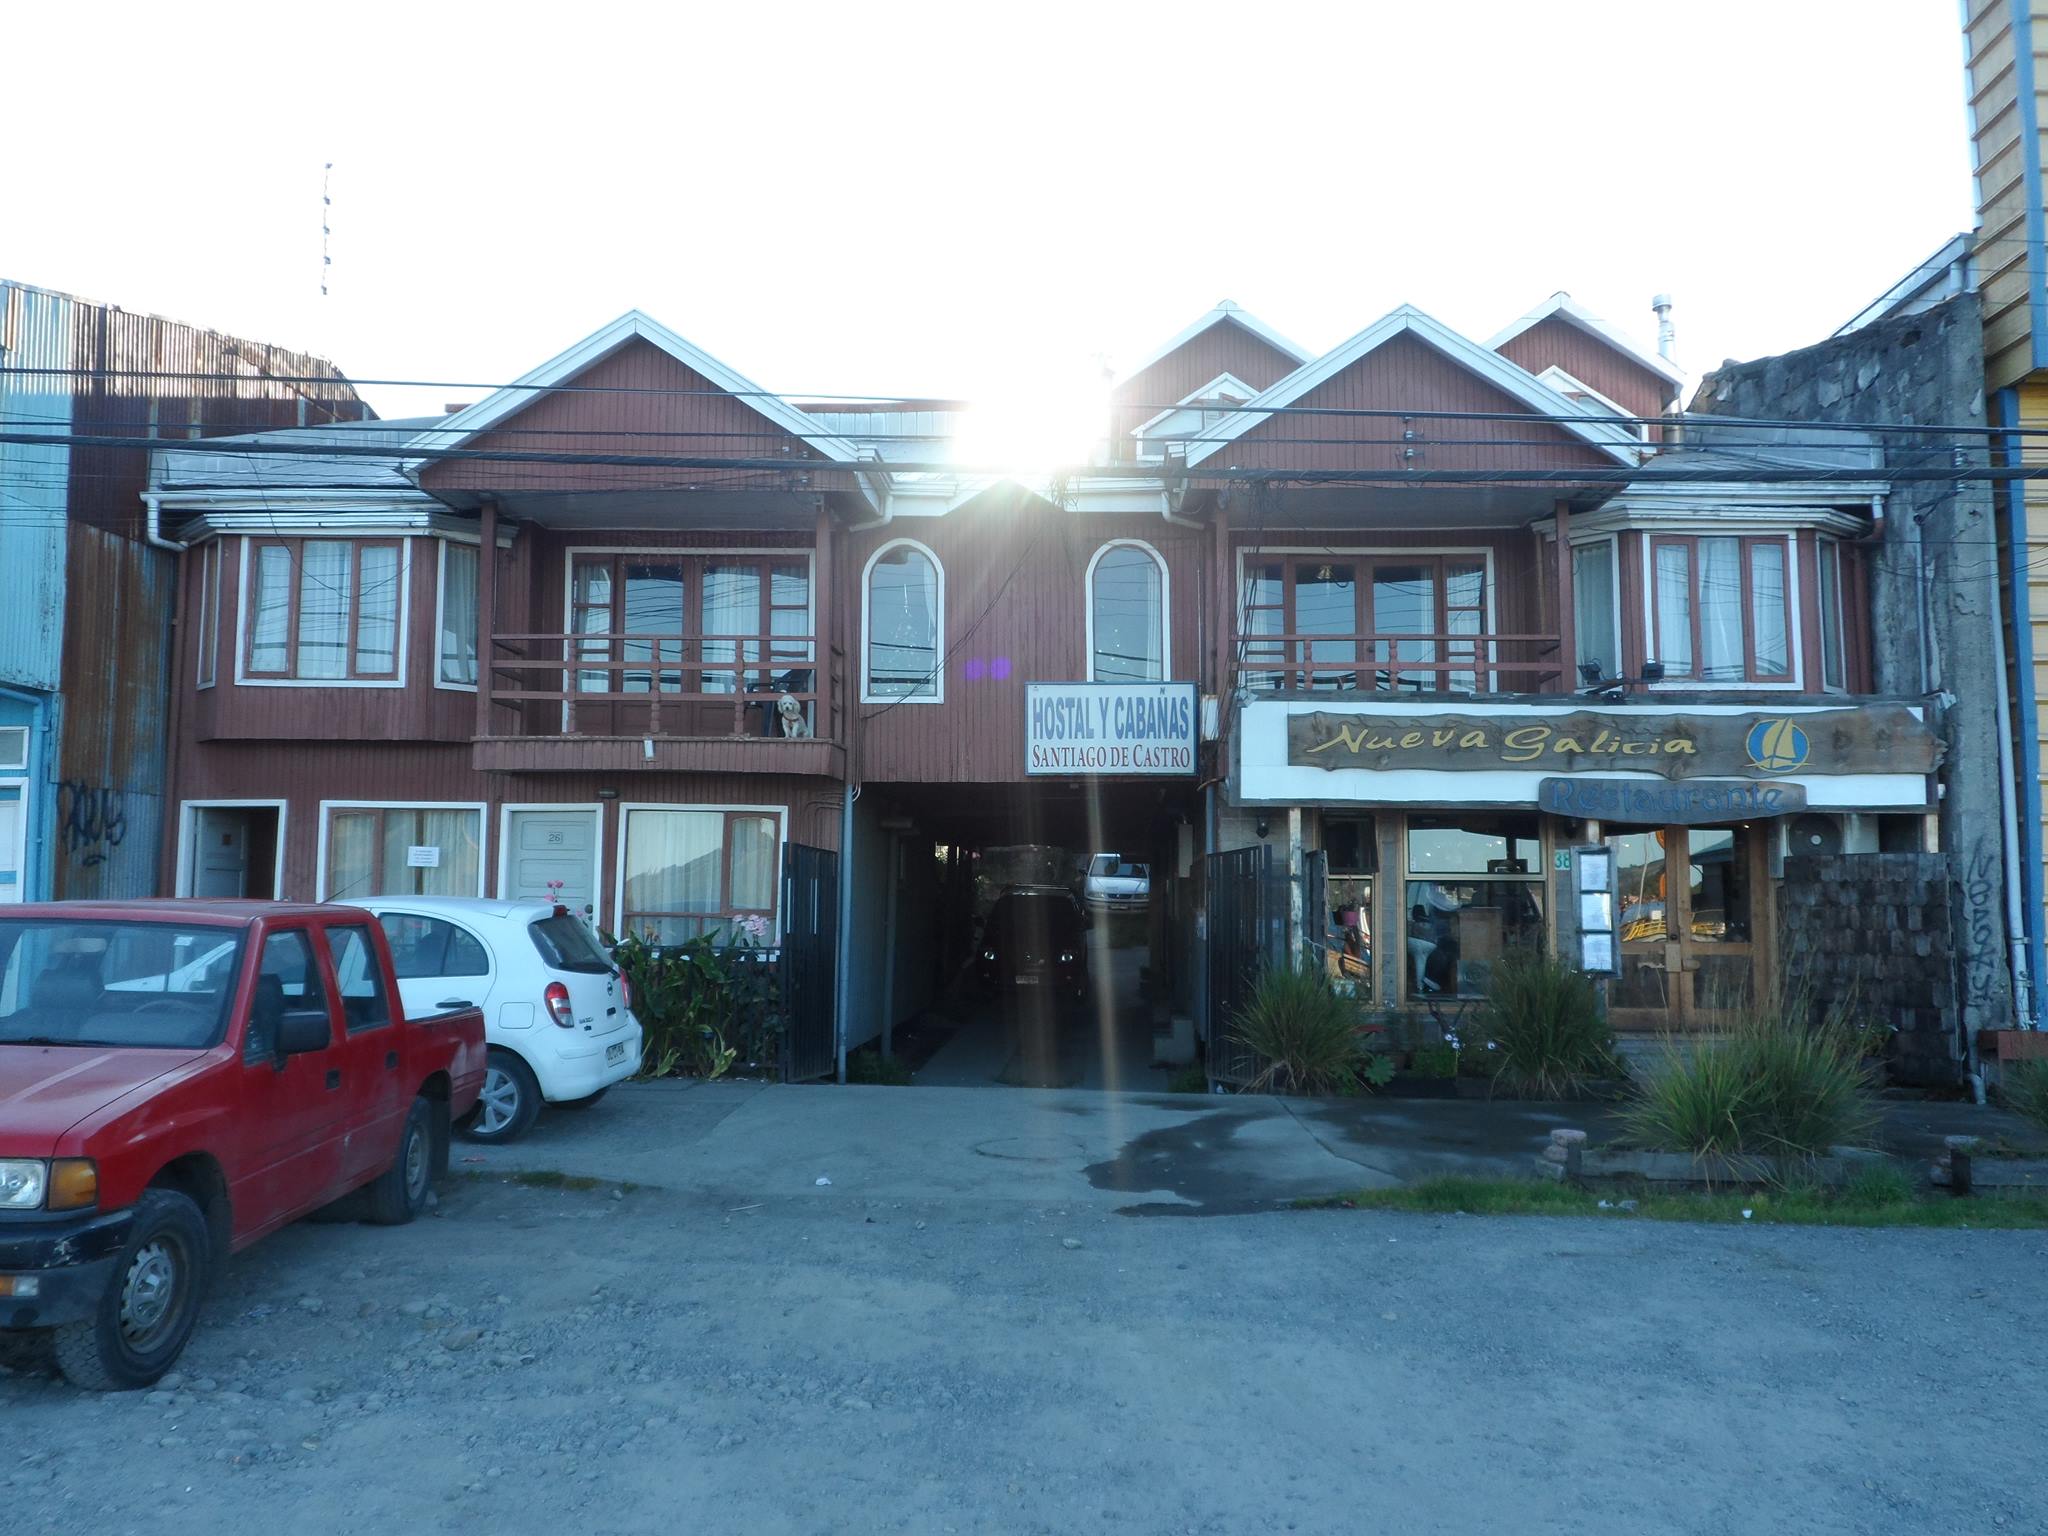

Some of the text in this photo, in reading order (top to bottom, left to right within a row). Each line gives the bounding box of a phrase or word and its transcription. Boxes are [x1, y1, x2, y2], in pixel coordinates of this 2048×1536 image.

[1032, 687, 1190, 740] HOSTAL Y CABAÑAS
[1032, 744, 1191, 768] SANTIAGO DE CASTRO
[1306, 725, 1697, 762] Nueva Galicia
[1551, 778, 1784, 812] Restaurante
